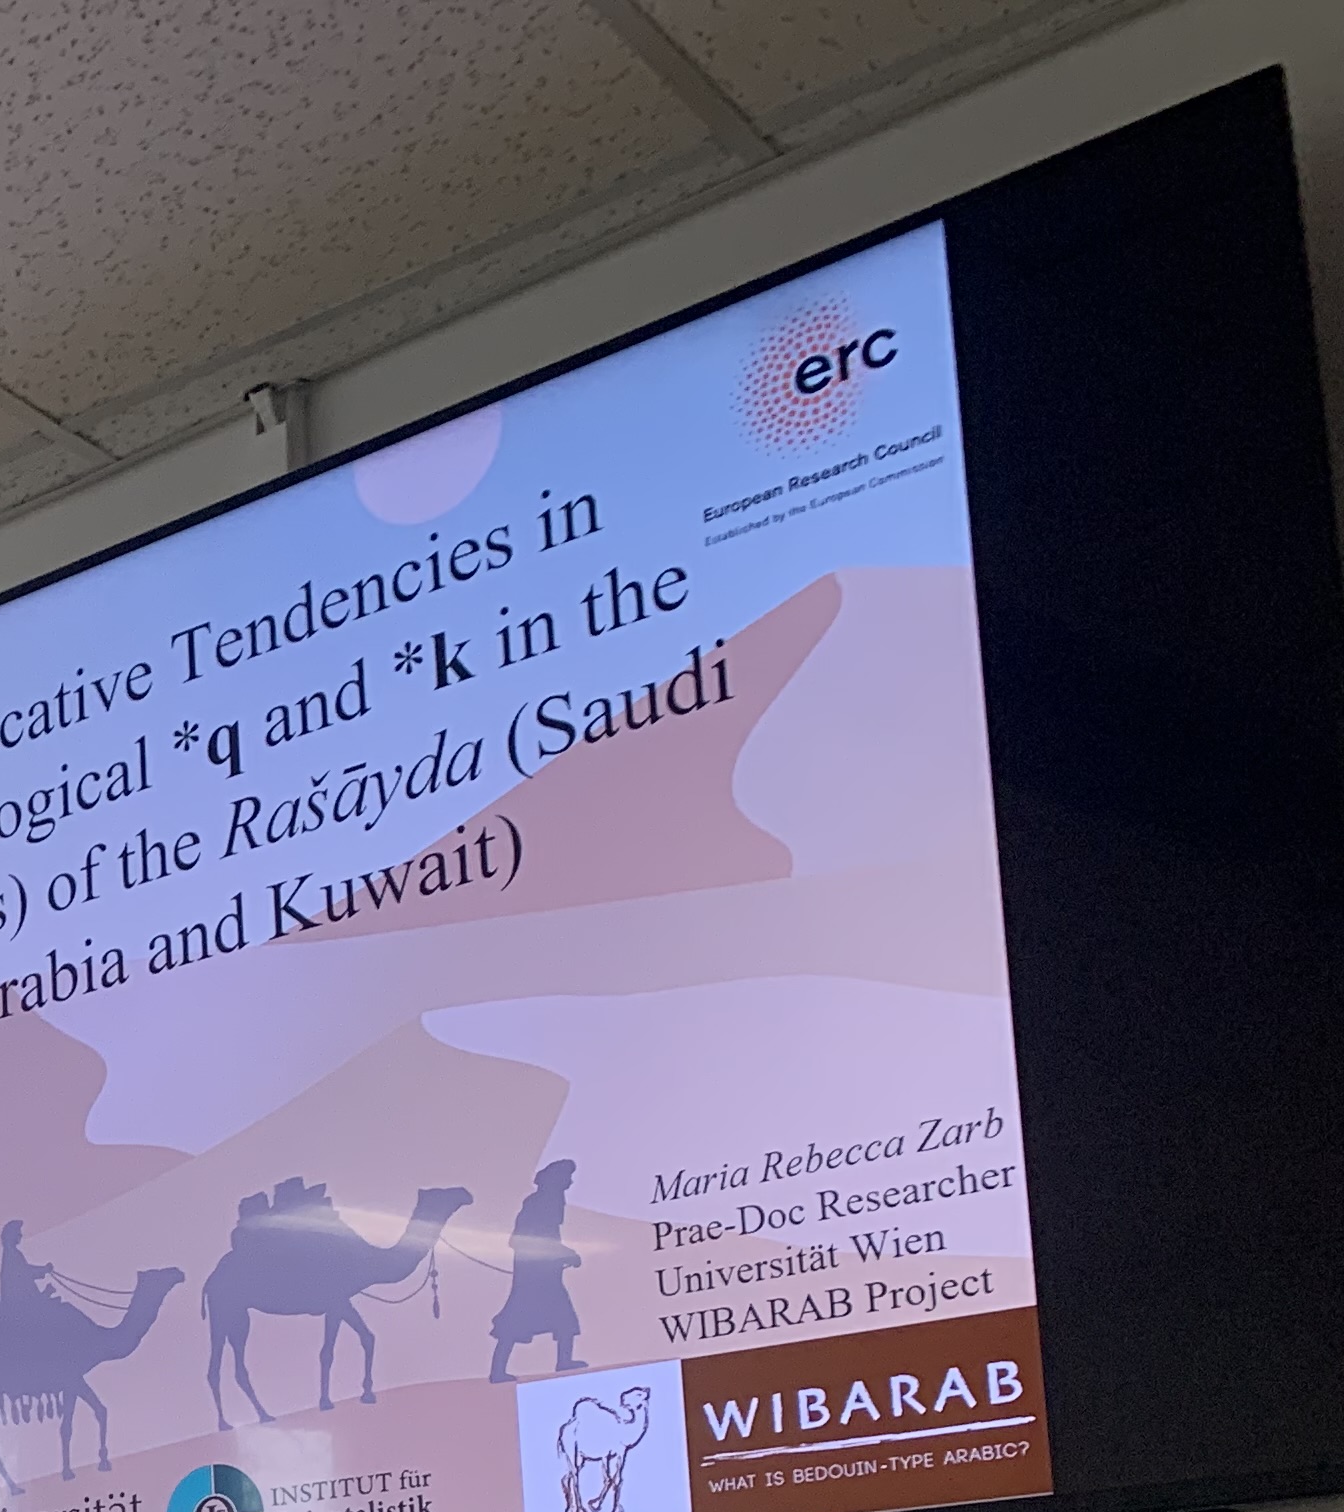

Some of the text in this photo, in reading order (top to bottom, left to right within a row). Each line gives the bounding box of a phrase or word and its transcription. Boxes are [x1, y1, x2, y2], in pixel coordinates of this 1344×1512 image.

[795, 328, 898, 394] erc
[703, 424, 942, 523] European Research Council
[170, 532, 514, 685] Tendencies
[538, 489, 604, 552] in
[264, 658, 370, 748] and
[497, 606, 561, 669] in
[583, 564, 689, 640] the
[47, 844, 107, 912] of
[121, 827, 201, 891] the
[223, 731, 483, 859] Rašāyda
[507, 638, 736, 777] (Saudi
[148, 893, 247, 975] and
[268, 814, 523, 940] Kuwait)
[650, 1107, 1004, 1205] Maria Rebecca Zarb
[652, 1163, 1017, 1251] Prae-Doc Researcher
[655, 1226, 948, 1297] Universität Wien
[658, 1268, 994, 1344] WIBARAB Project
[703, 1360, 1024, 1443] WIBARAB
[271, 1469, 431, 1507] INSTITUT für
[708, 1473, 756, 1493] WHAT
[764, 1471, 786, 1488] IS
[943, 1441, 1030, 1467] ARABIC?
